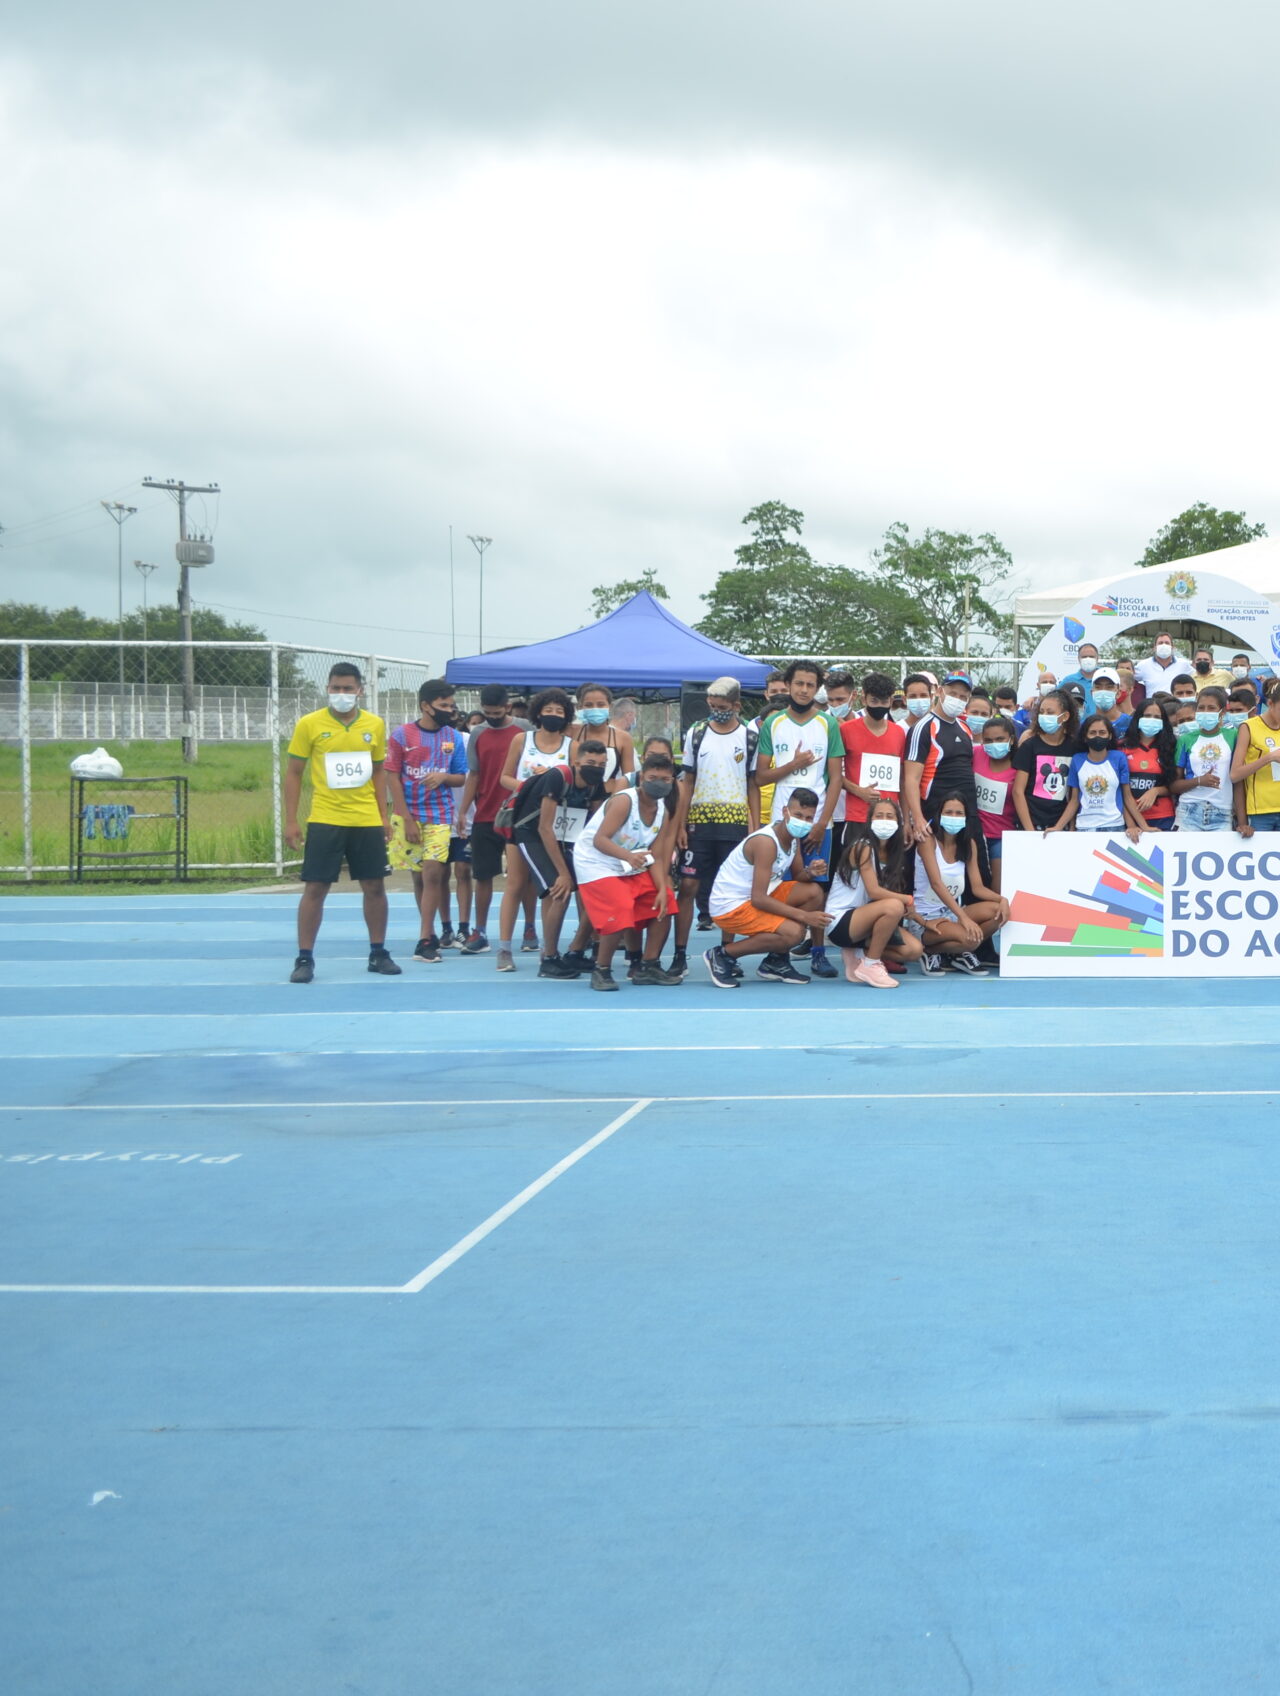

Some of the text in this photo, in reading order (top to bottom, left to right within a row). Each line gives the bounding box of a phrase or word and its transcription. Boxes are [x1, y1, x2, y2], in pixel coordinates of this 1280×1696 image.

[1118, 604, 1160, 612] ESCOLARES
[1119, 597, 1144, 605] JOGOS
[1169, 604, 1191, 612] ACRE
[1063, 644, 1080, 652] CBD
[335, 762, 364, 777] 964
[405, 765, 449, 779] Rakute
[869, 764, 893, 780] 968
[976, 784, 998, 804] 985
[555, 815, 578, 831] 967
[684, 849, 694, 866] 9
[1172, 930, 1230, 957] DO
[0, 1151, 243, 1164] Playpis
